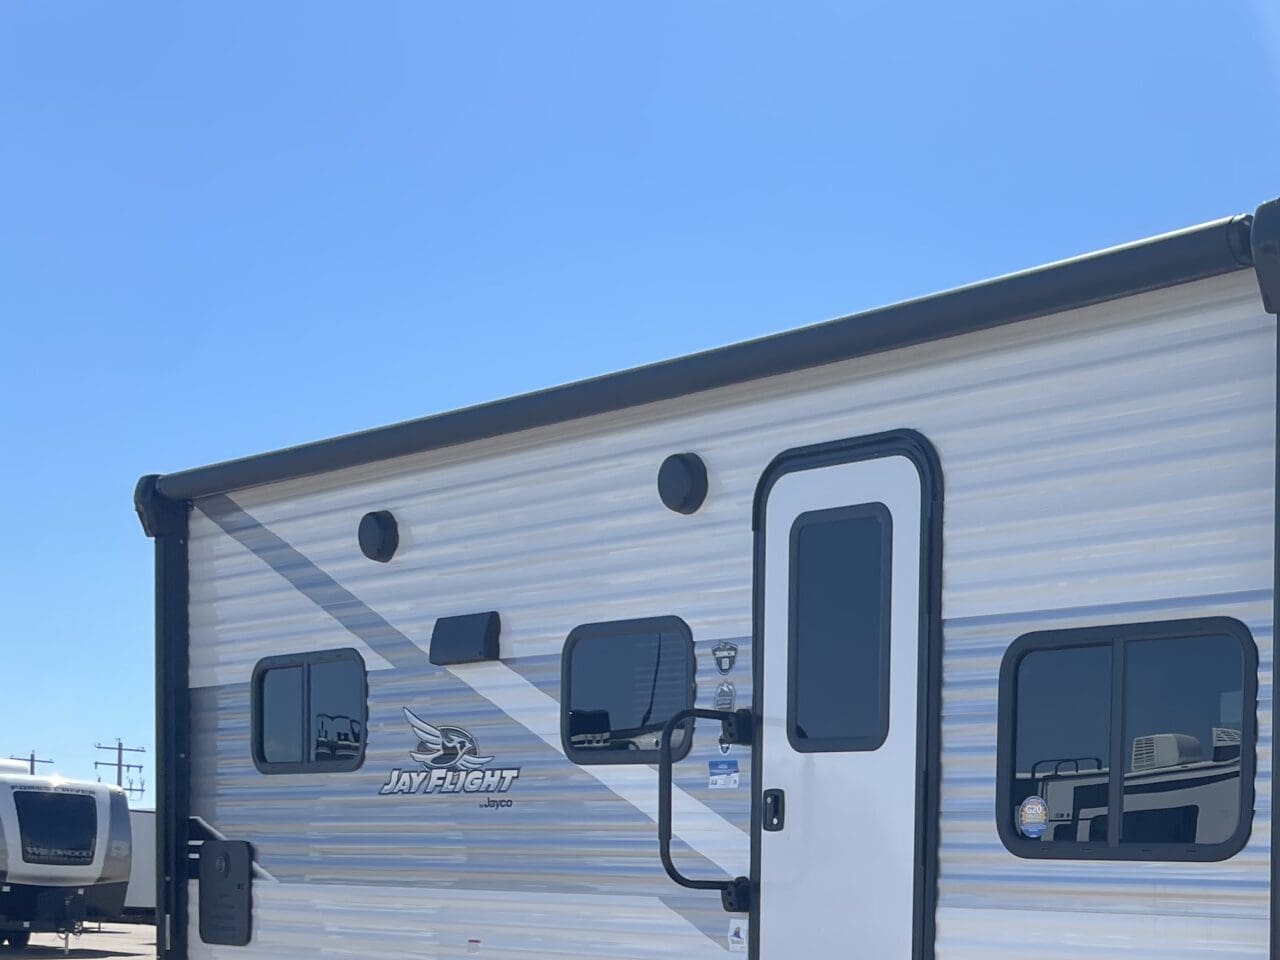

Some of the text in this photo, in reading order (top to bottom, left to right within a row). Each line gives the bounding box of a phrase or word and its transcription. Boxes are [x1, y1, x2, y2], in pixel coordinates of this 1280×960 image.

[379, 767, 521, 795] JAY FLIGHT
[485, 797, 513, 810] Jayco
[1026, 804, 1042, 814] G20
